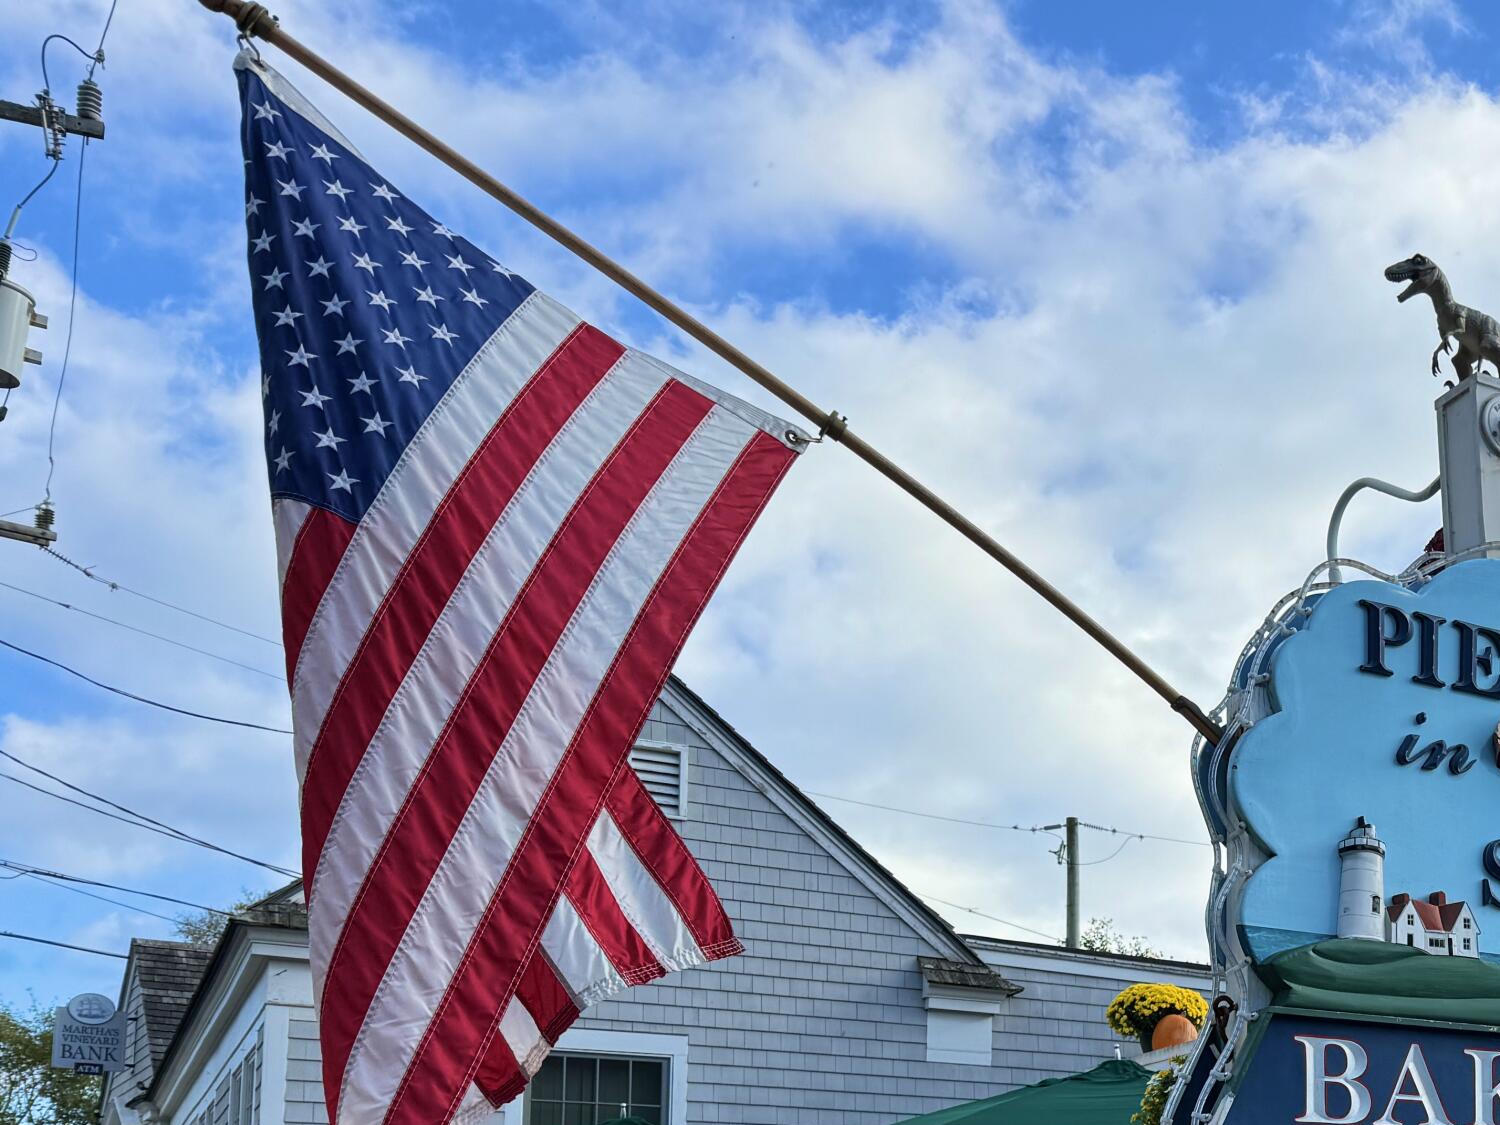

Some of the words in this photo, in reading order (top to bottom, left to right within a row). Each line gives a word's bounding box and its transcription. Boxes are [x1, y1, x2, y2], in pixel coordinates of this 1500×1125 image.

[1395, 711, 1477, 776] in
[62, 1034, 119, 1046] VINEYARD
[60, 1044, 119, 1062] BANK
[77, 1065, 99, 1074] ATM
